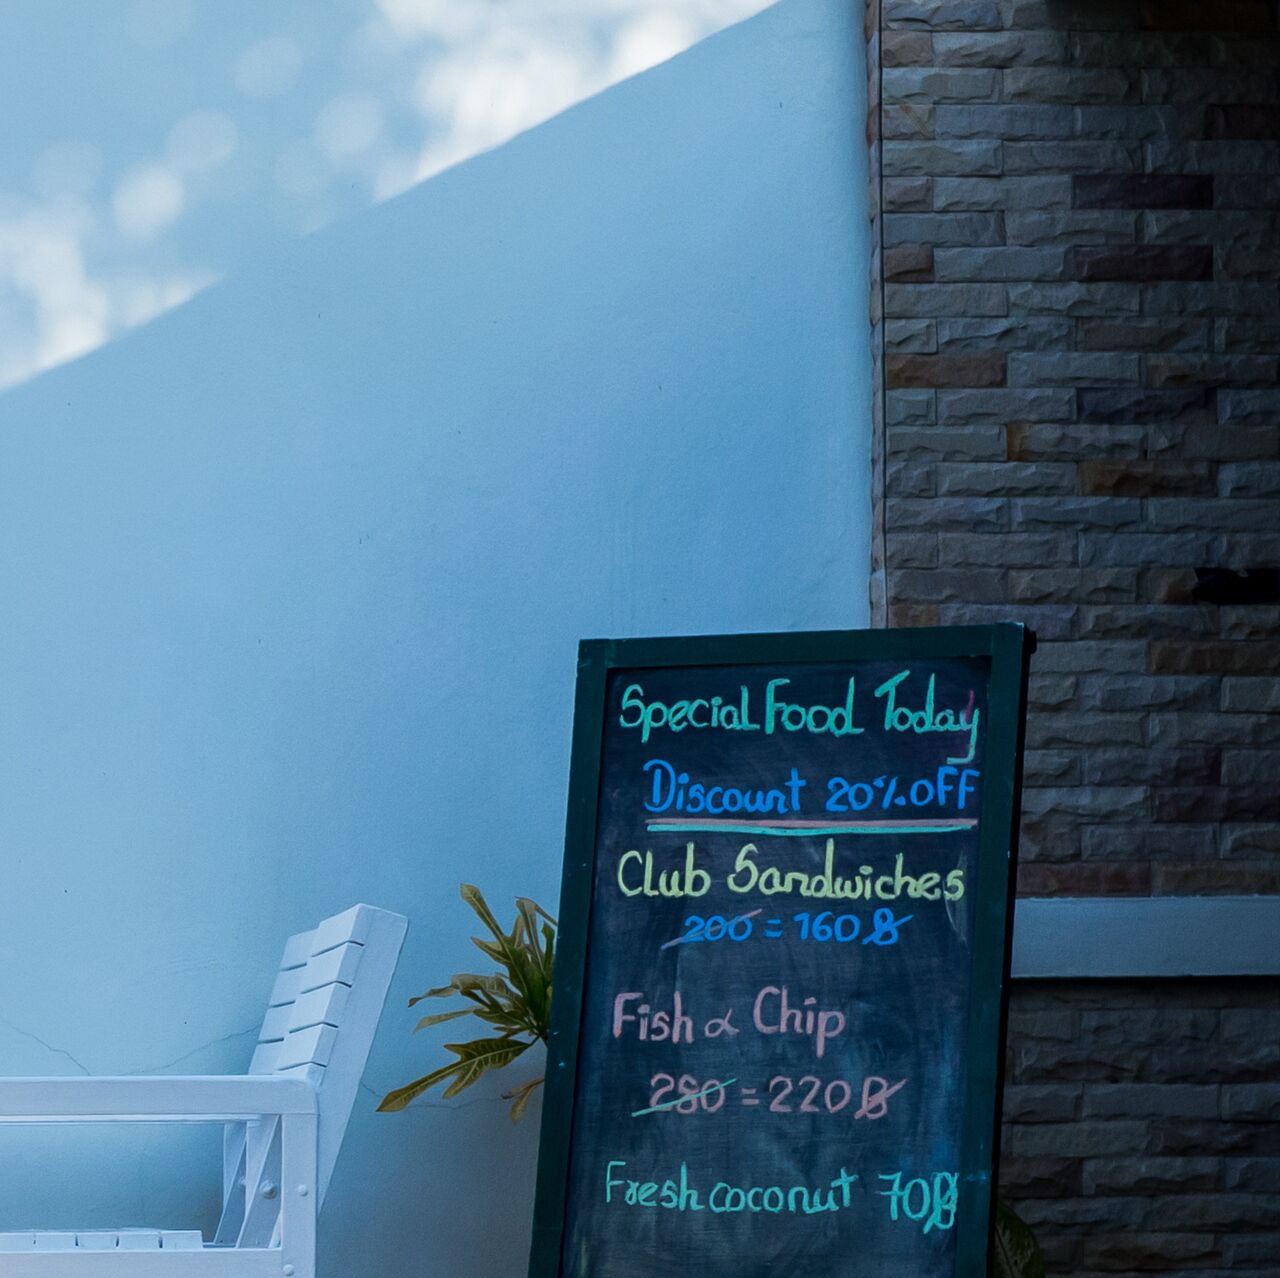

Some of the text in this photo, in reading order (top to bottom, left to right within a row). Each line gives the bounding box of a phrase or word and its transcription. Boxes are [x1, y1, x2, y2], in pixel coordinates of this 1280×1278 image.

[620, 670, 980, 764] Special Food Today
[643, 760, 807, 814] Discount
[618, 838, 965, 901] Club Sandwiches
[612, 991, 694, 1043] Fish
[753, 985, 846, 1058] Chip
[605, 1161, 699, 1212] Fresh
[710, 1166, 859, 1214] coconut
